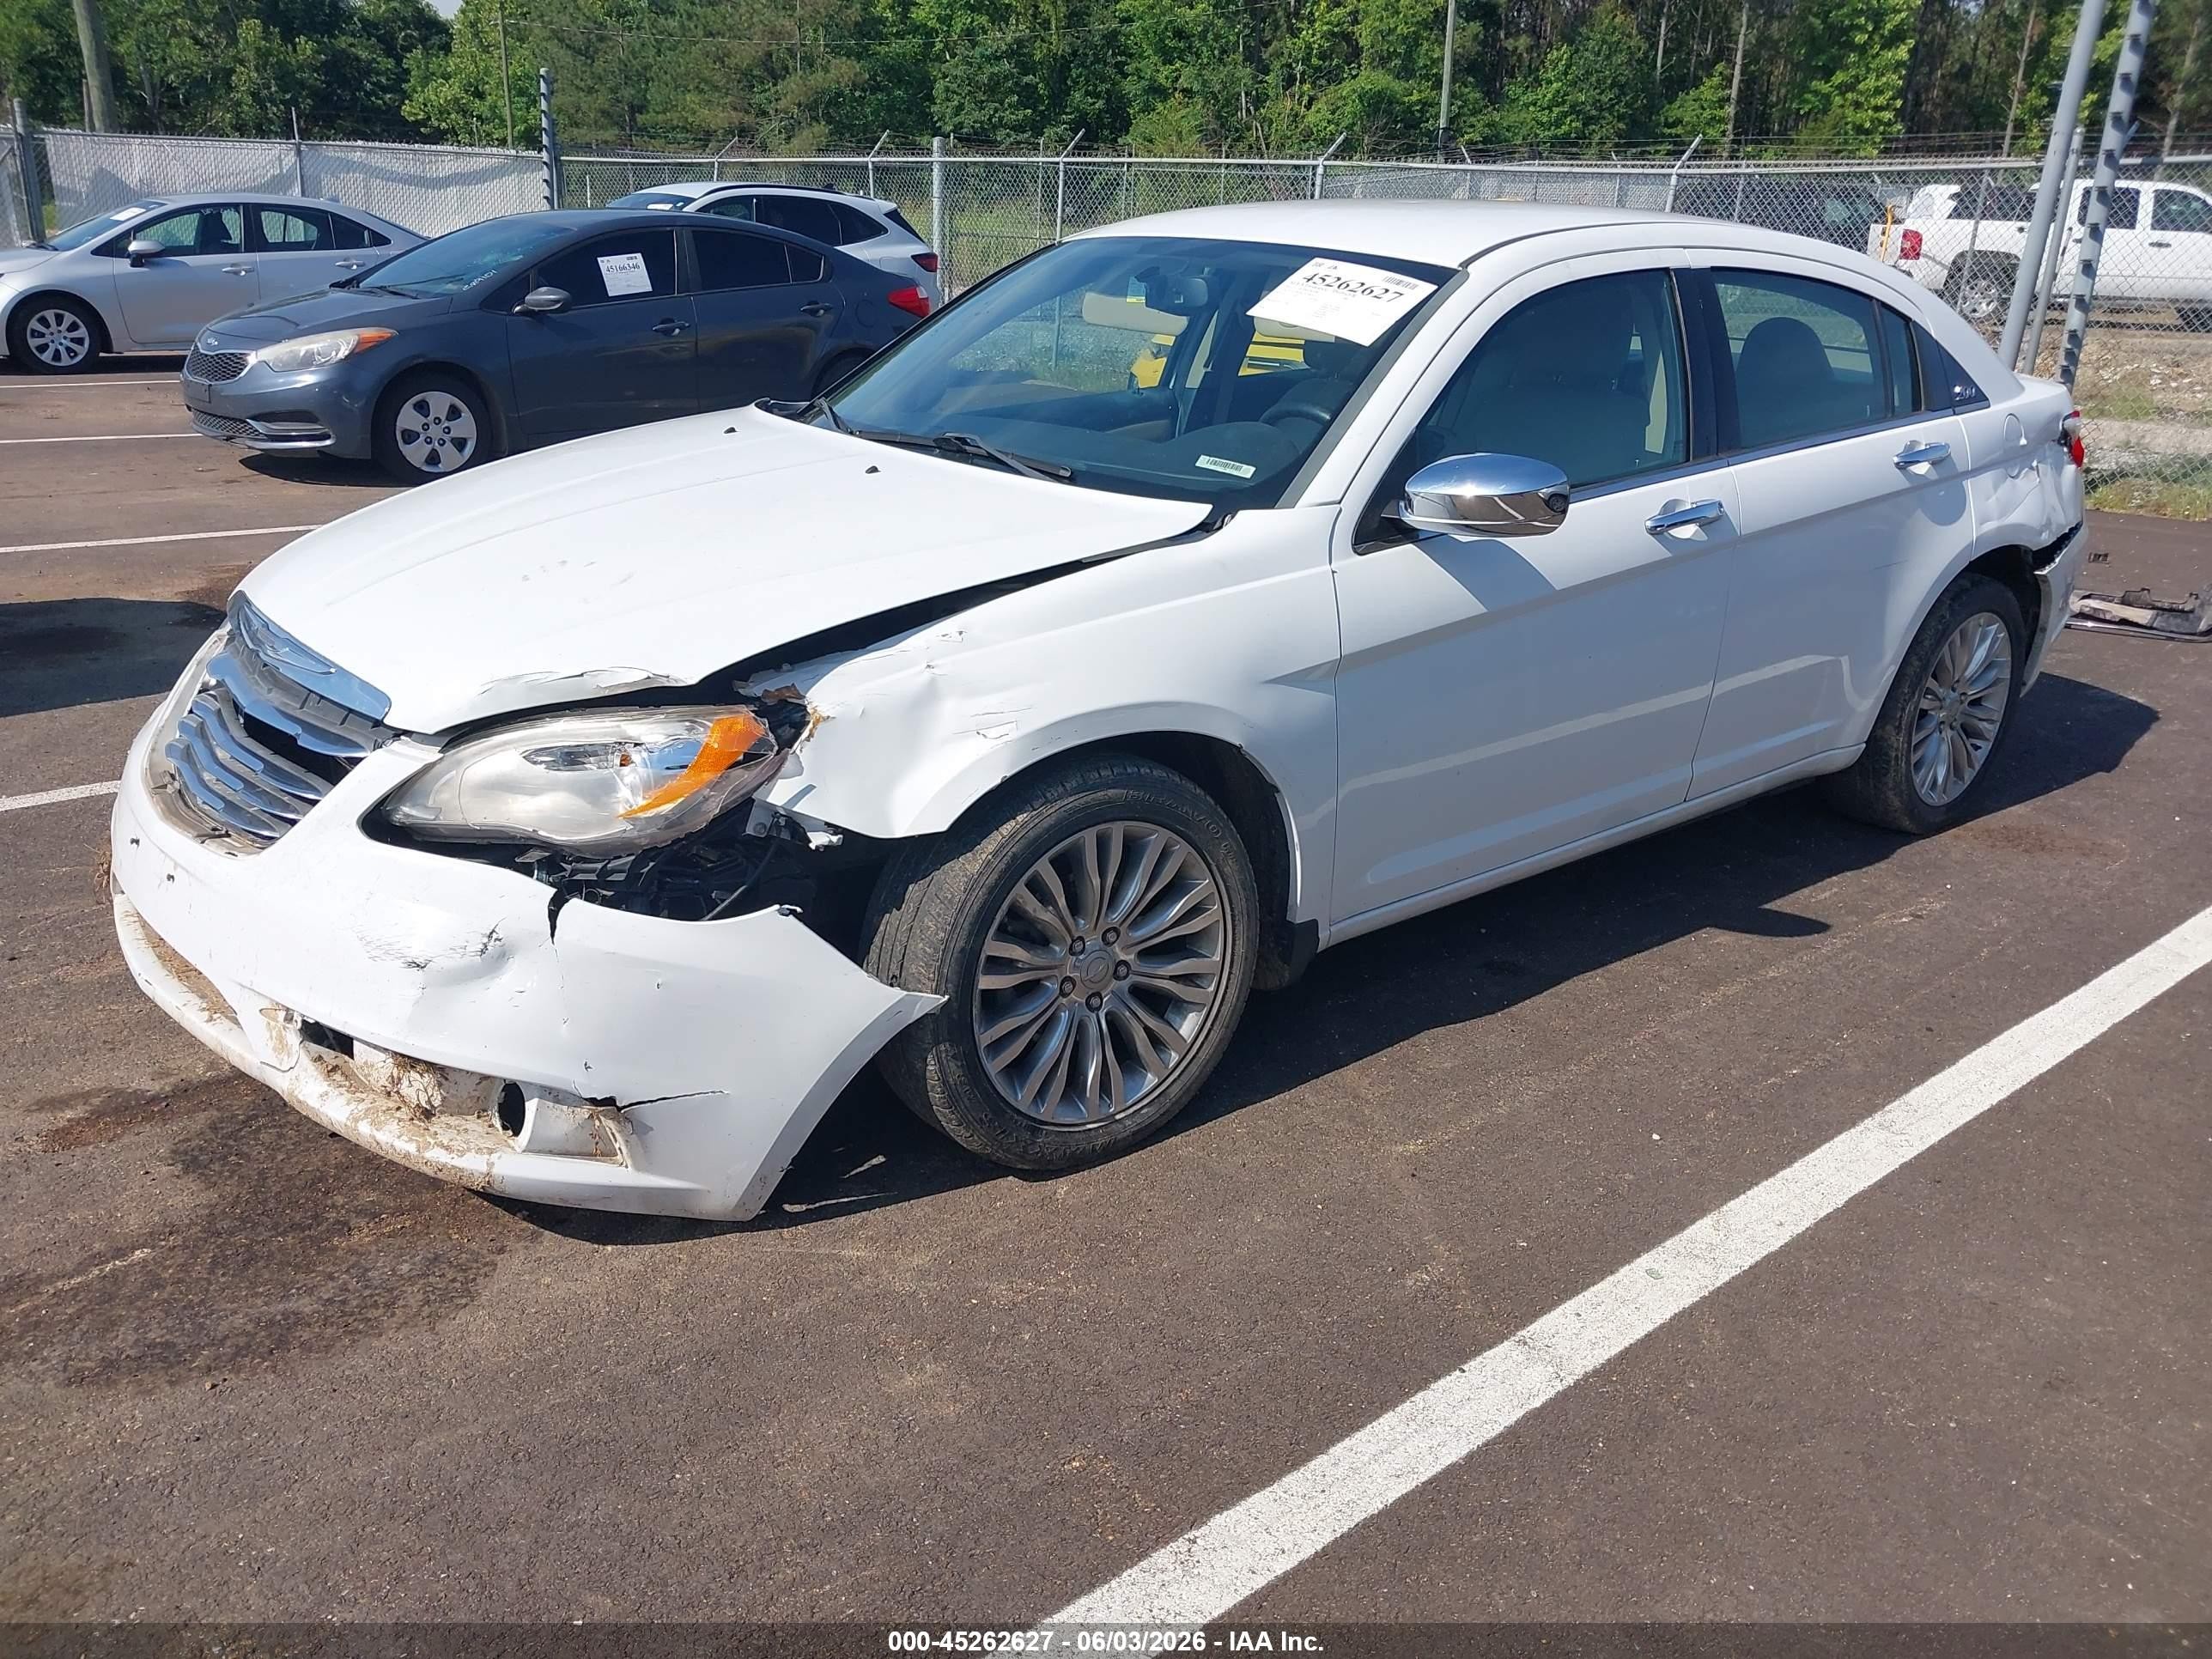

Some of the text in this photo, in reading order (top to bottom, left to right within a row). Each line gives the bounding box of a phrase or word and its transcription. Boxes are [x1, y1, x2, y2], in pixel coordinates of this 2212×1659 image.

[605, 261, 641, 273] 45166346
[1303, 272, 1405, 302] 45262627
[1953, 384, 1977, 401] 200
